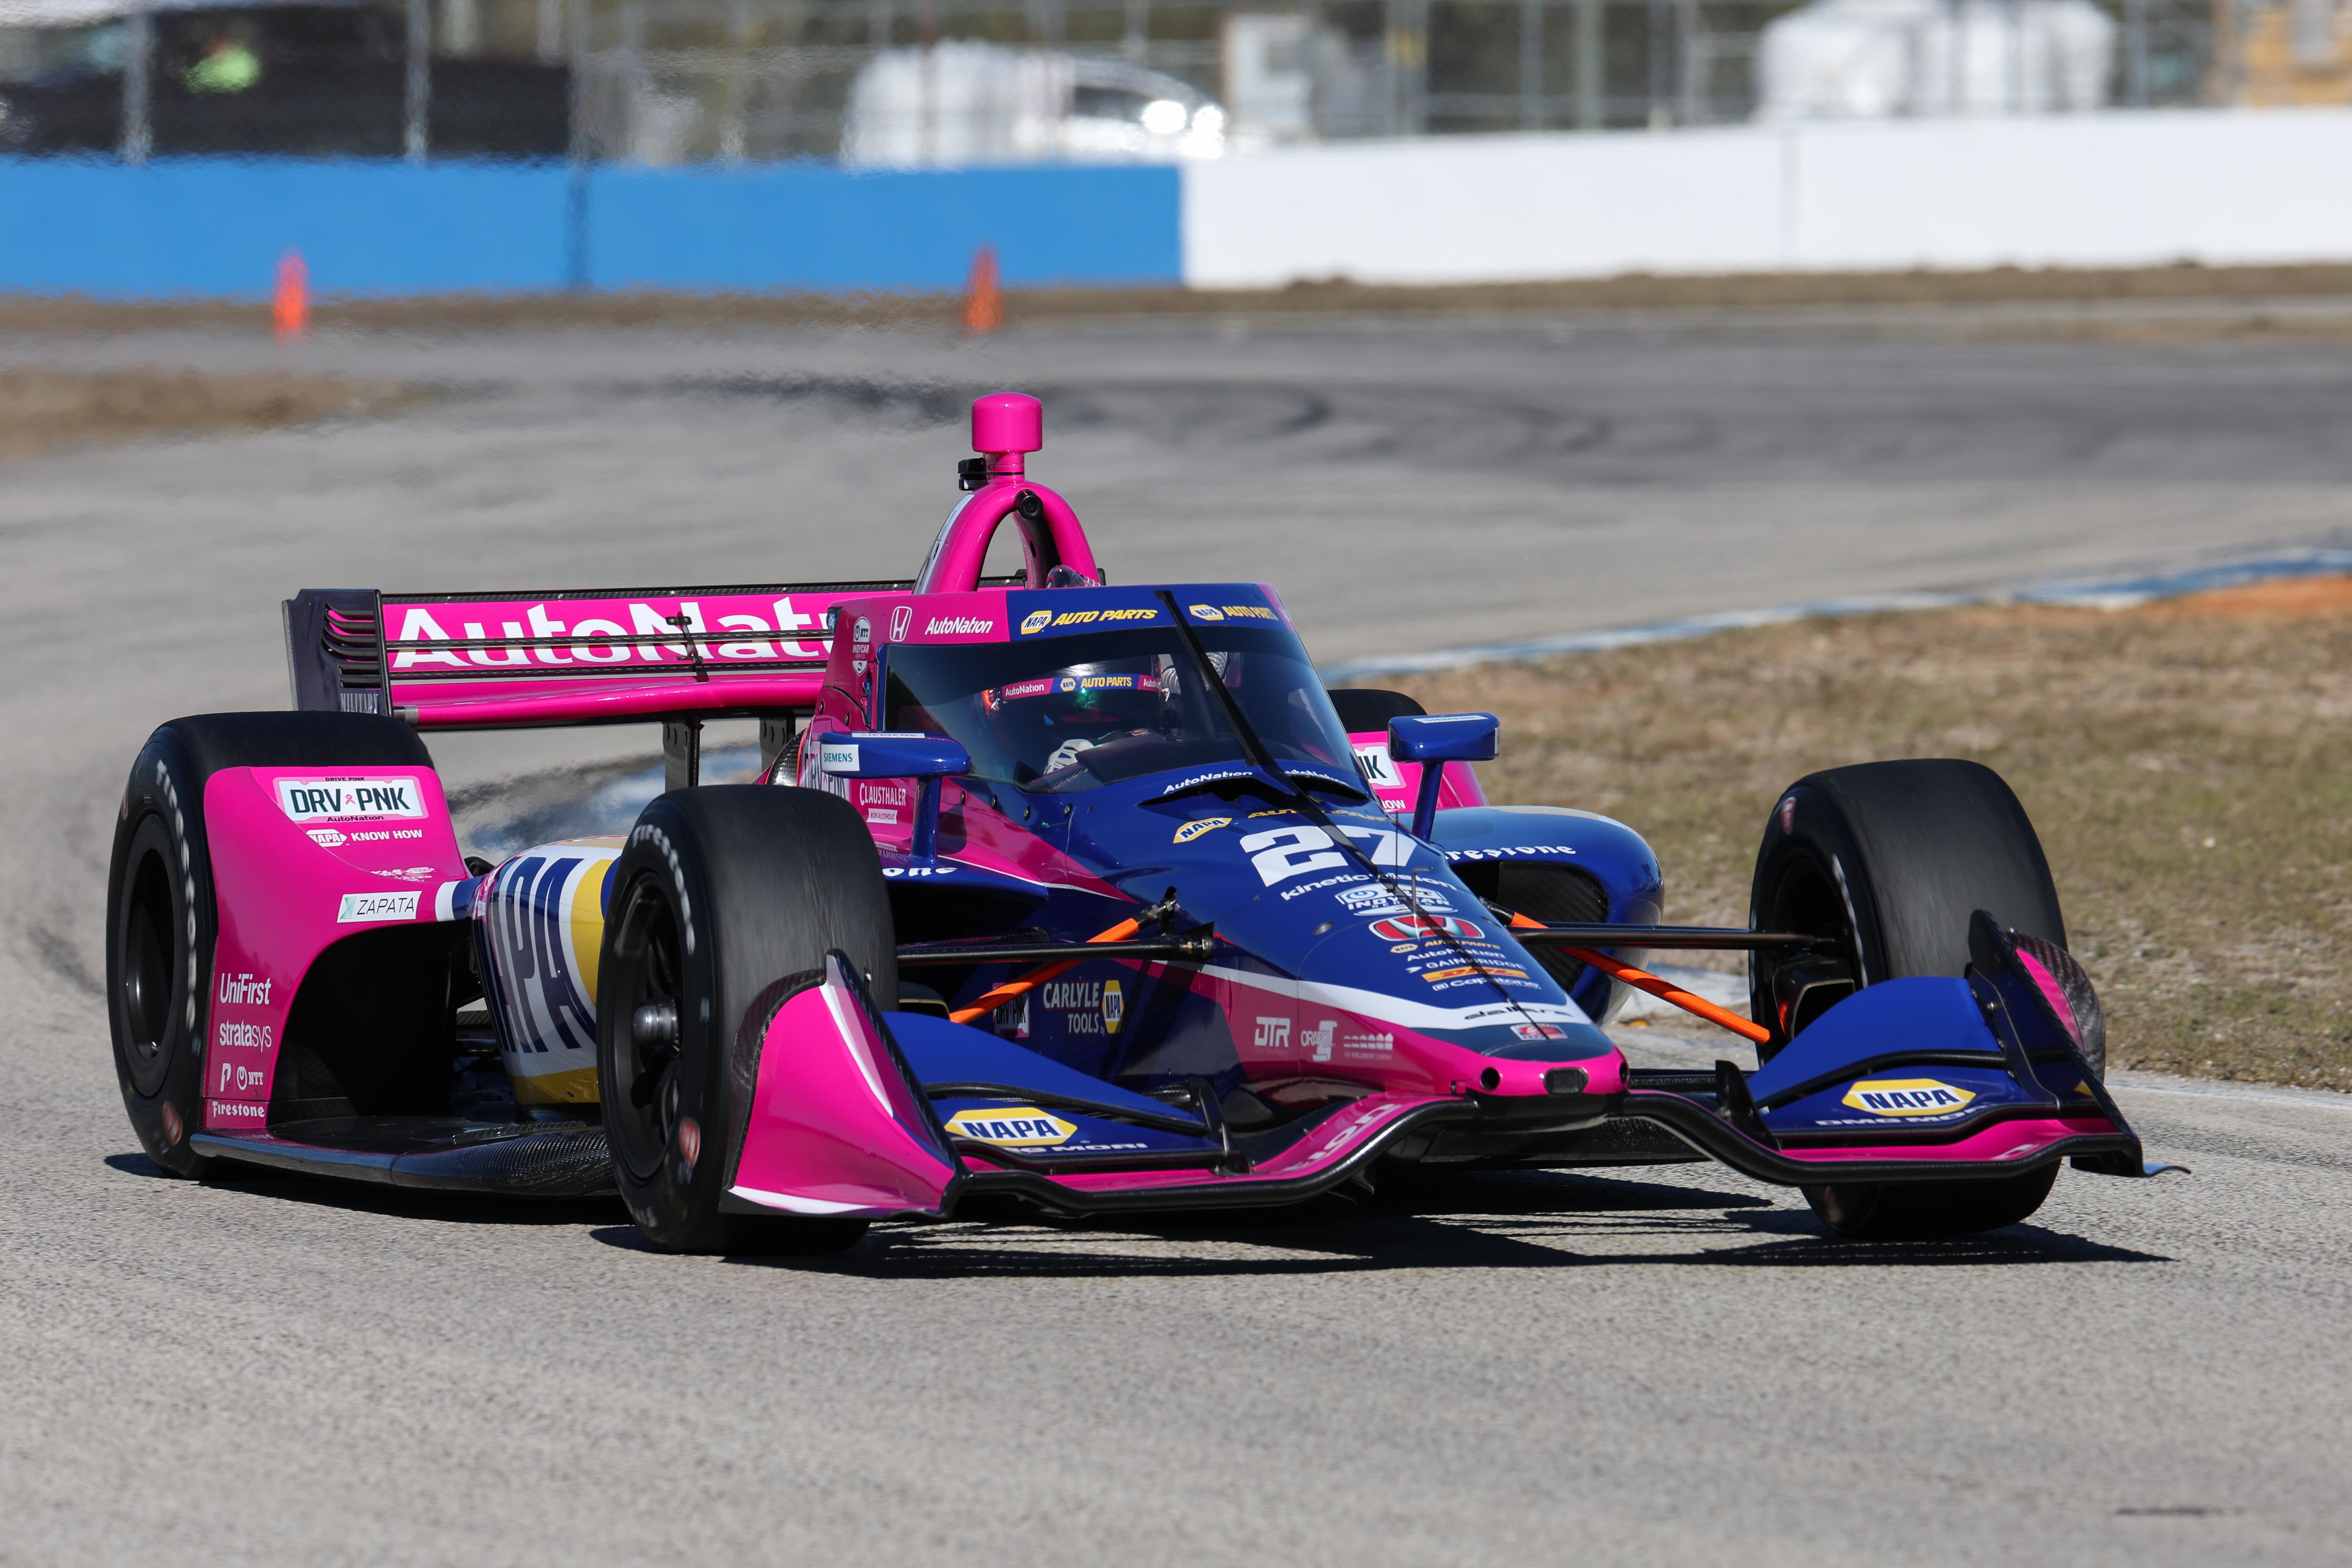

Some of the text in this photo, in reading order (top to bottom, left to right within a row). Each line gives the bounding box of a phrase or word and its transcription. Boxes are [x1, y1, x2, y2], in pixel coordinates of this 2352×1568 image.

[925, 617, 993, 635] AutoNation
[1025, 616, 1048, 628] NAPA
[1051, 609, 1158, 626] AUTO PARTS
[860, 628, 869, 637] NTT
[853, 645, 869, 653] INDYCAR
[1005, 684, 1045, 697] AutoNation
[1080, 677, 1132, 688] AUTO PARTS
[824, 753, 853, 762] SIEMENS
[1162, 770, 1252, 794] AutoNation
[290, 787, 411, 813] DRV PNK
[860, 783, 906, 806] CLAUSTHALER
[870, 812, 895, 821] NON-ALCOHOLIC
[351, 831, 389, 841] KNOW
[392, 829, 423, 839] HOW
[1179, 819, 1224, 839] NAPA
[1240, 825, 1417, 887] 27
[357, 897, 414, 915] ZAPATA
[1348, 897, 1450, 910] INDYAR
[1426, 957, 1527, 971] GAINRIDGE
[220, 973, 272, 1005] UniFirst
[1043, 982, 1099, 1009] CARLYLE
[1105, 995, 1121, 1019] NAPA
[1068, 1012, 1104, 1036] TOOLS by
[220, 1020, 272, 1052] stratasys
[248, 1072, 264, 1085] NTT
[212, 1100, 265, 1118] Firestone
[1861, 1090, 1960, 1110] NAPA
[960, 1119, 1061, 1139] NAPA
